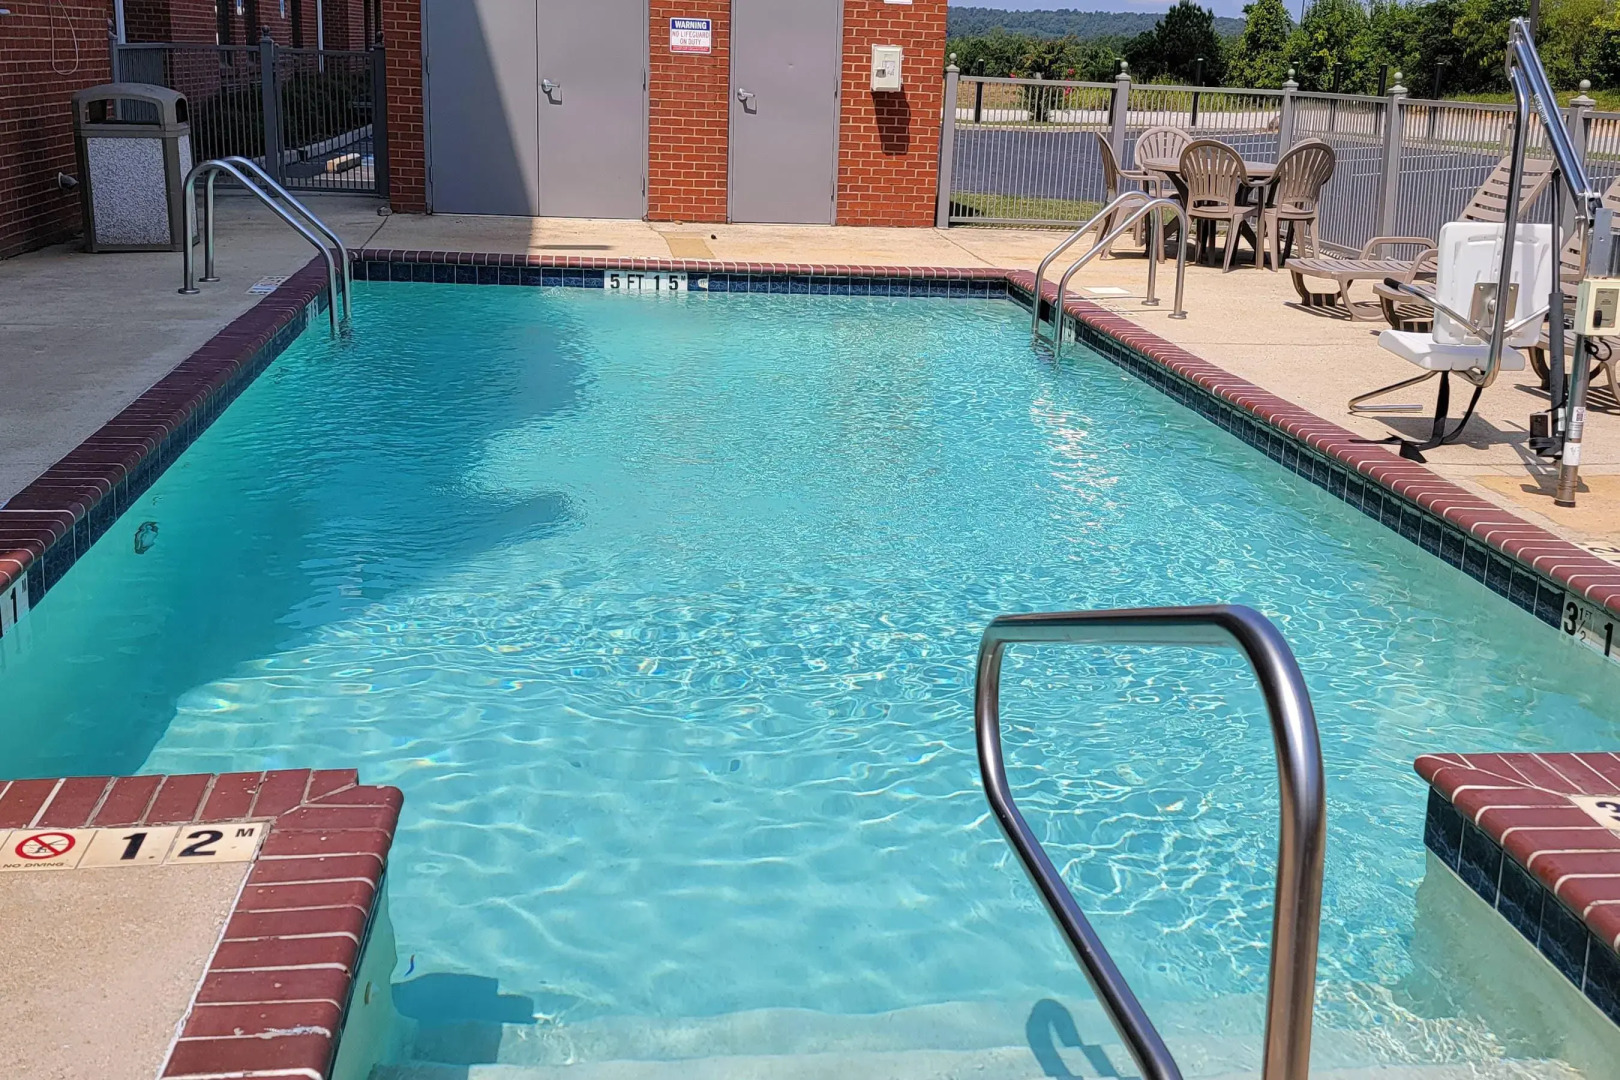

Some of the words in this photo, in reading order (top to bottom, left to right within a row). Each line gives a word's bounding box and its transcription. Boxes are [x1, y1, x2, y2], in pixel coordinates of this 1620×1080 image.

[674, 20, 707, 30] WARNING
[680, 31, 710, 39] LIFEGUARD
[627, 274, 645, 290] FT
